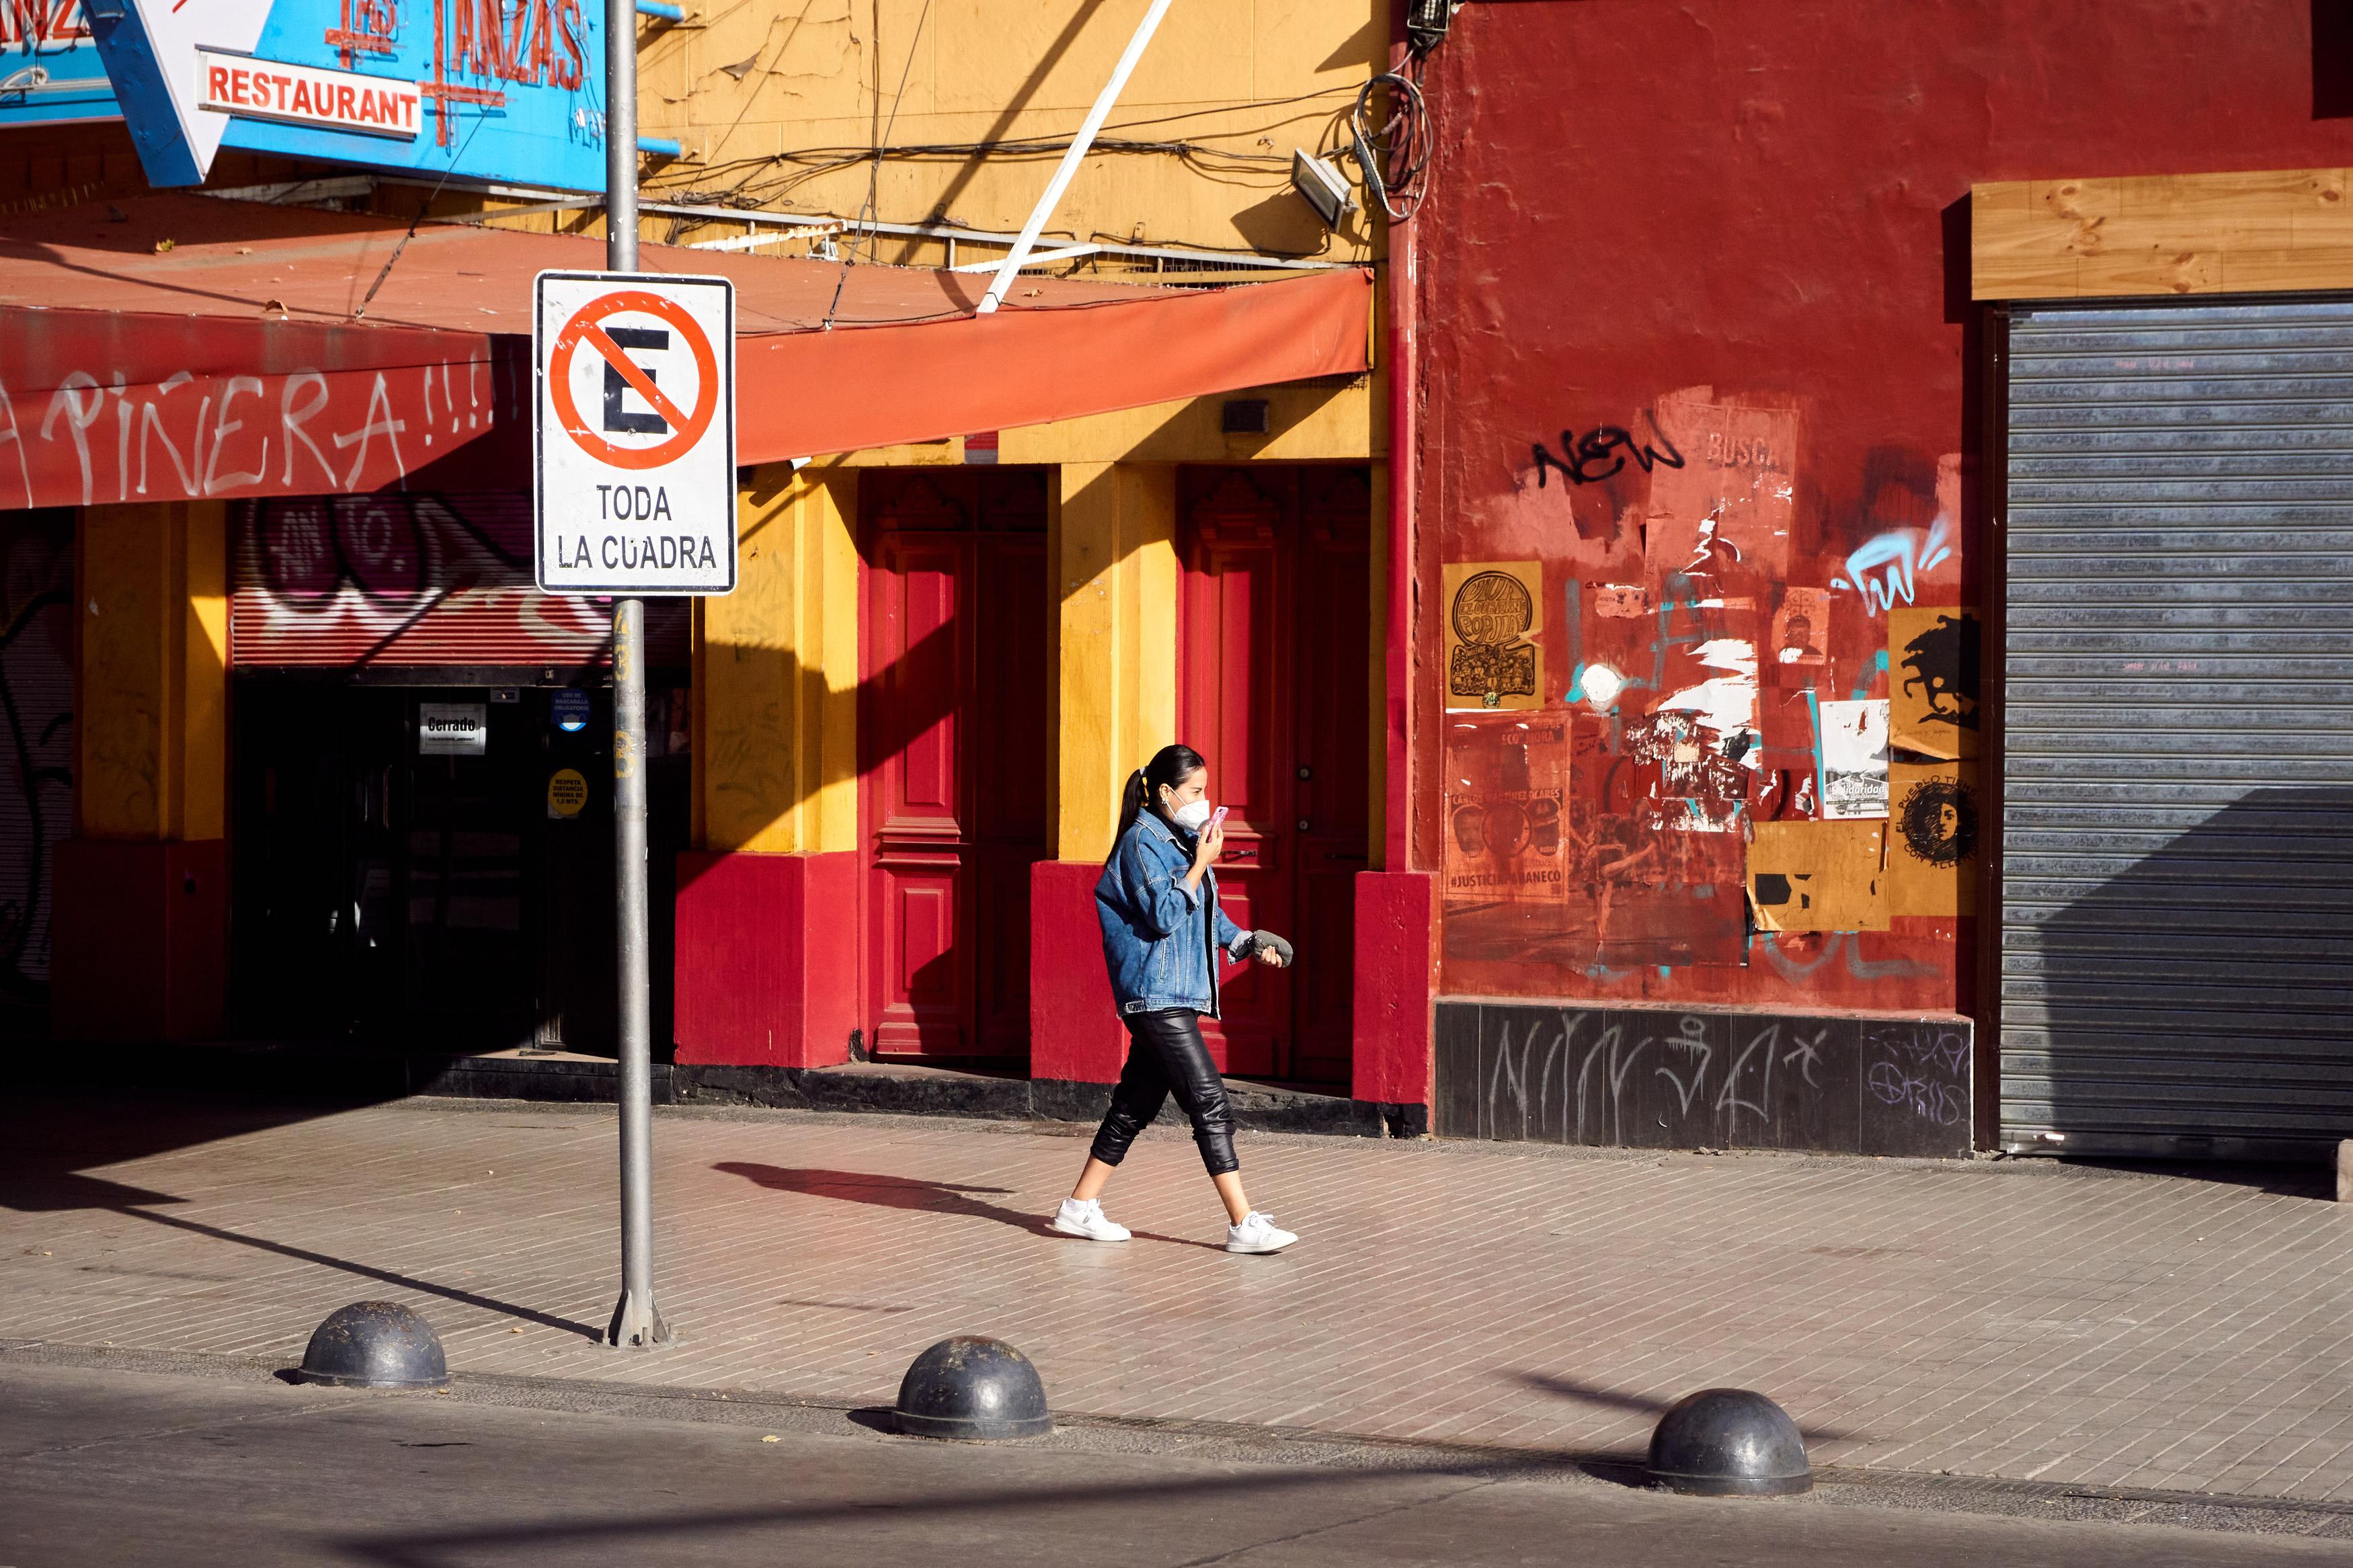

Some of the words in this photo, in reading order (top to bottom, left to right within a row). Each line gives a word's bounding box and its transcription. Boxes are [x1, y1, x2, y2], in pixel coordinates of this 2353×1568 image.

[209, 65, 418, 130] RESTAURANT
[596, 485, 672, 521] TODA
[558, 535, 593, 569] LA
[602, 536, 717, 569] CUADRA
[428, 716, 475, 732] Cerrado
[1899, 774, 1940, 809] PUEBLO
[1904, 843, 1926, 863] CON
